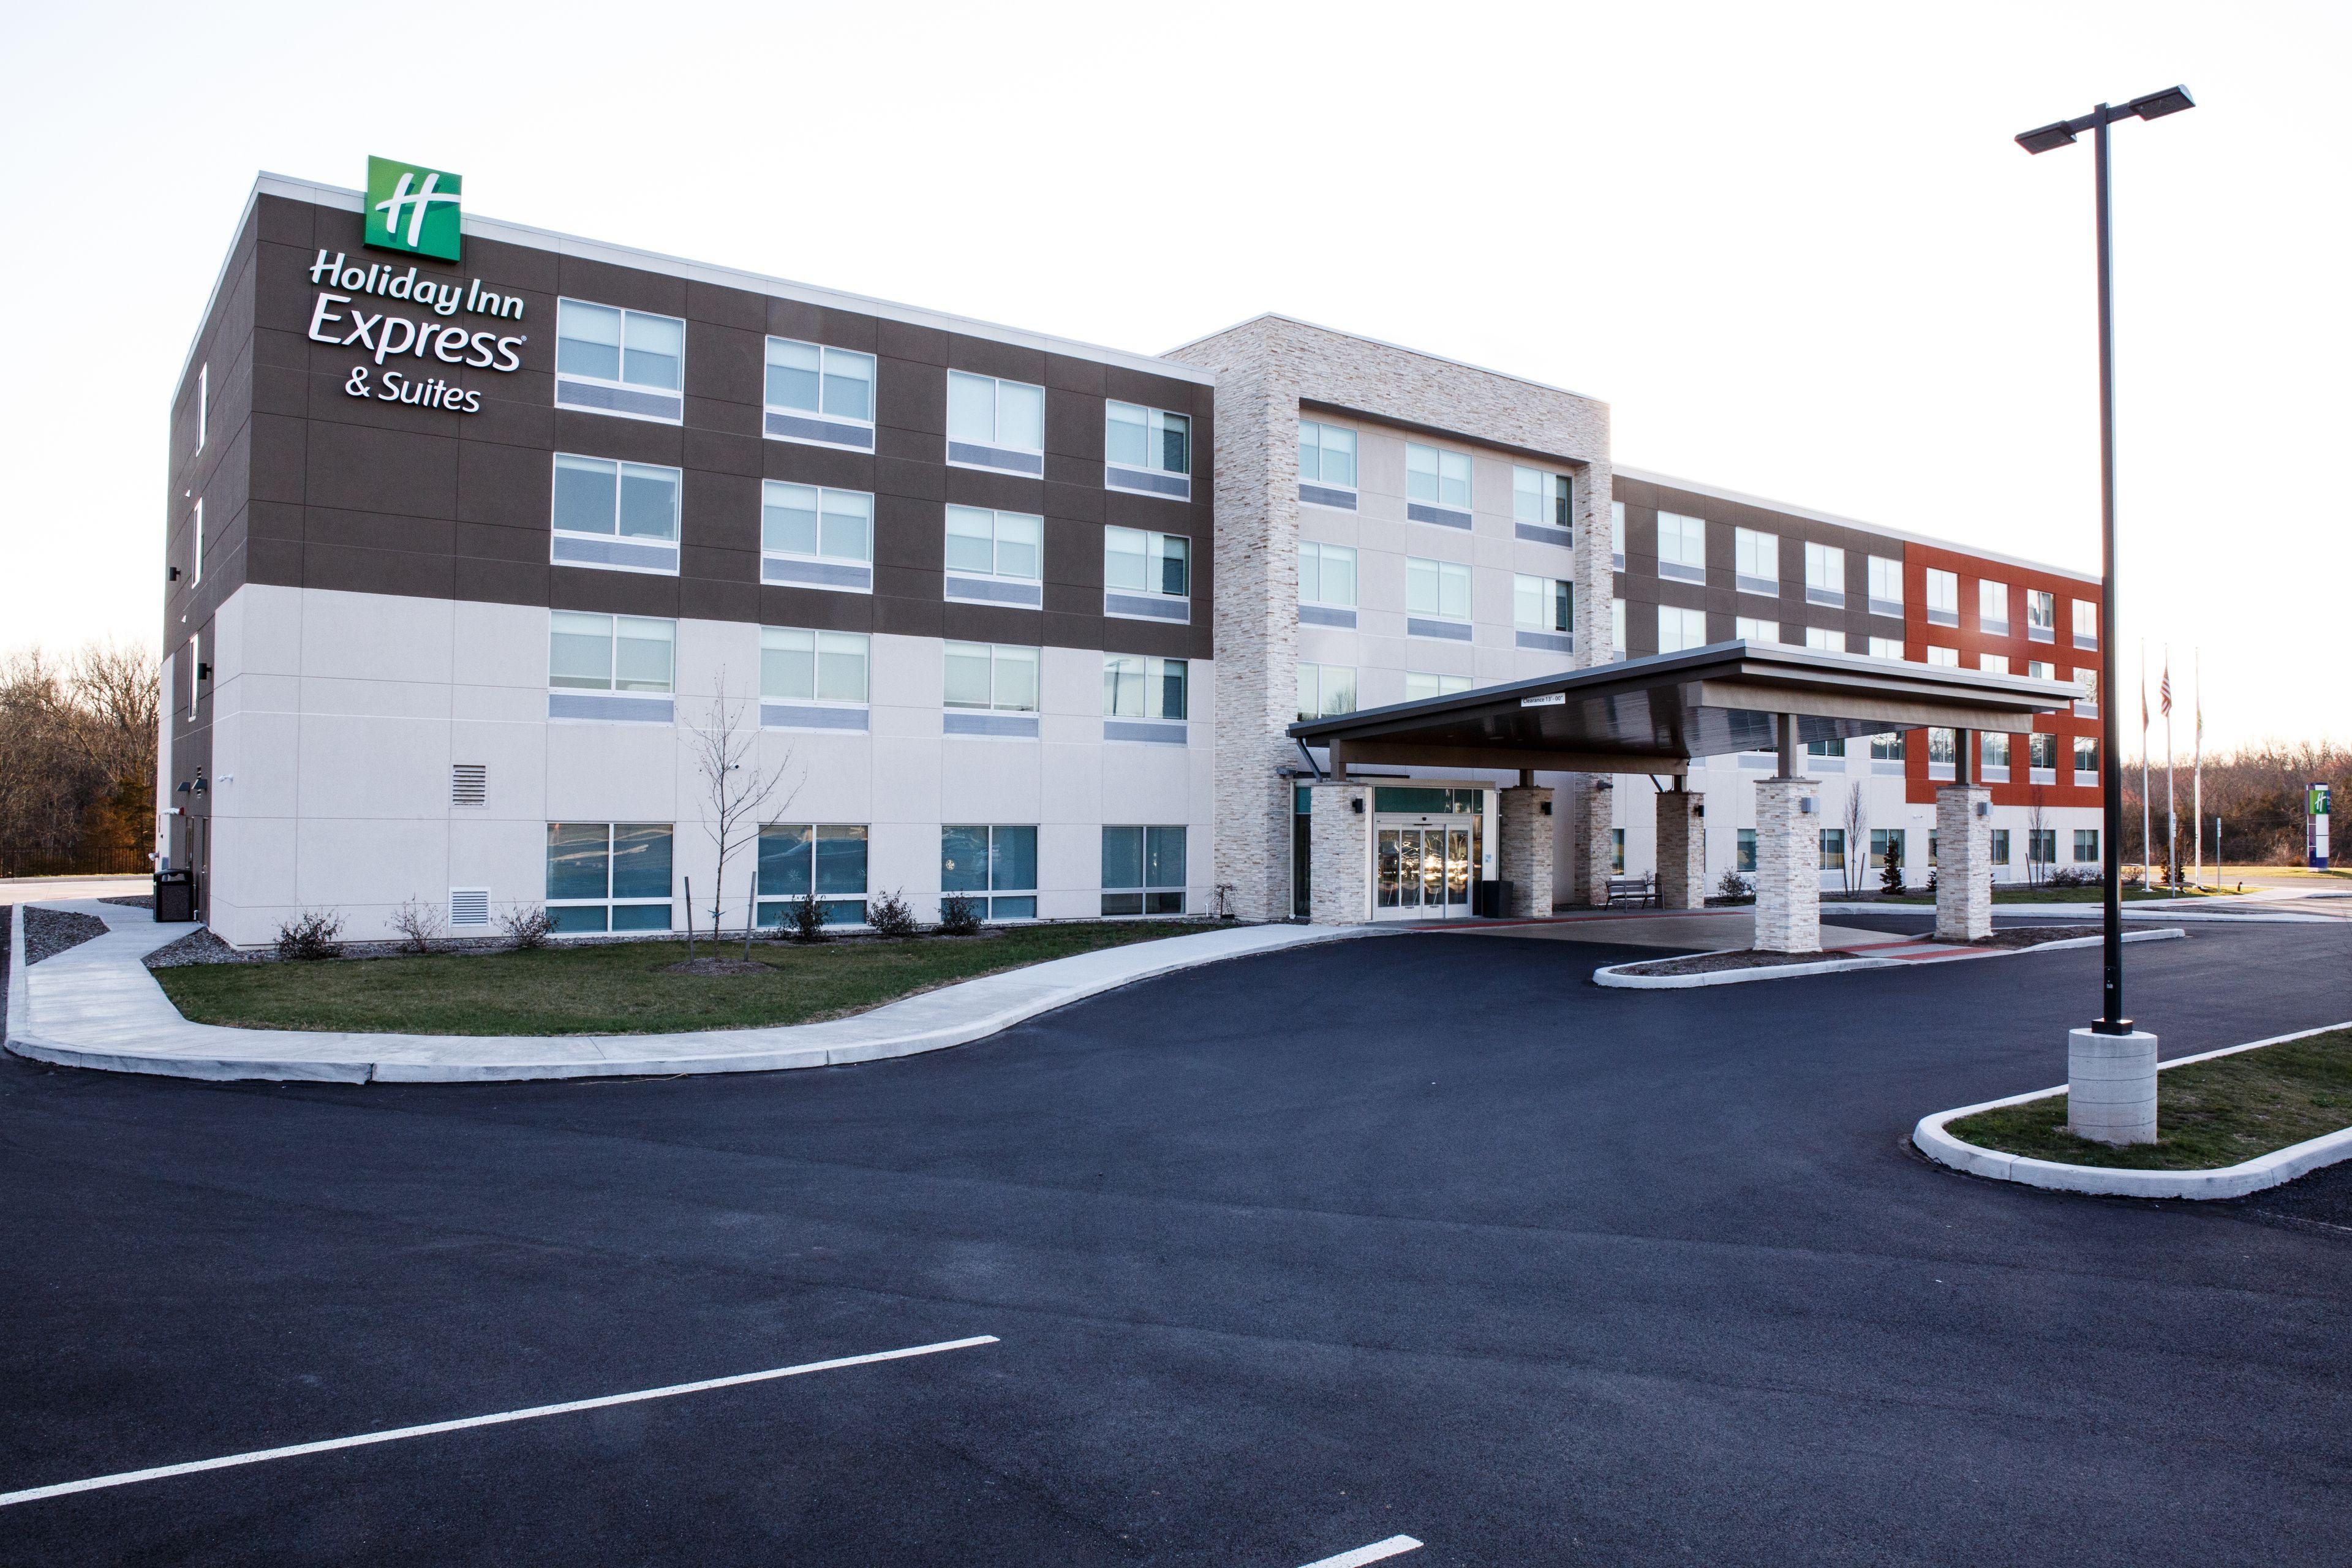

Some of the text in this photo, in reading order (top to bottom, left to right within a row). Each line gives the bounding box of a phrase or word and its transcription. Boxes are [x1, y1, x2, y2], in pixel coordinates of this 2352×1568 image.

[309, 249, 524, 320] Holiday Inn
[308, 292, 522, 372] Express
[345, 366, 481, 413] & Suites
